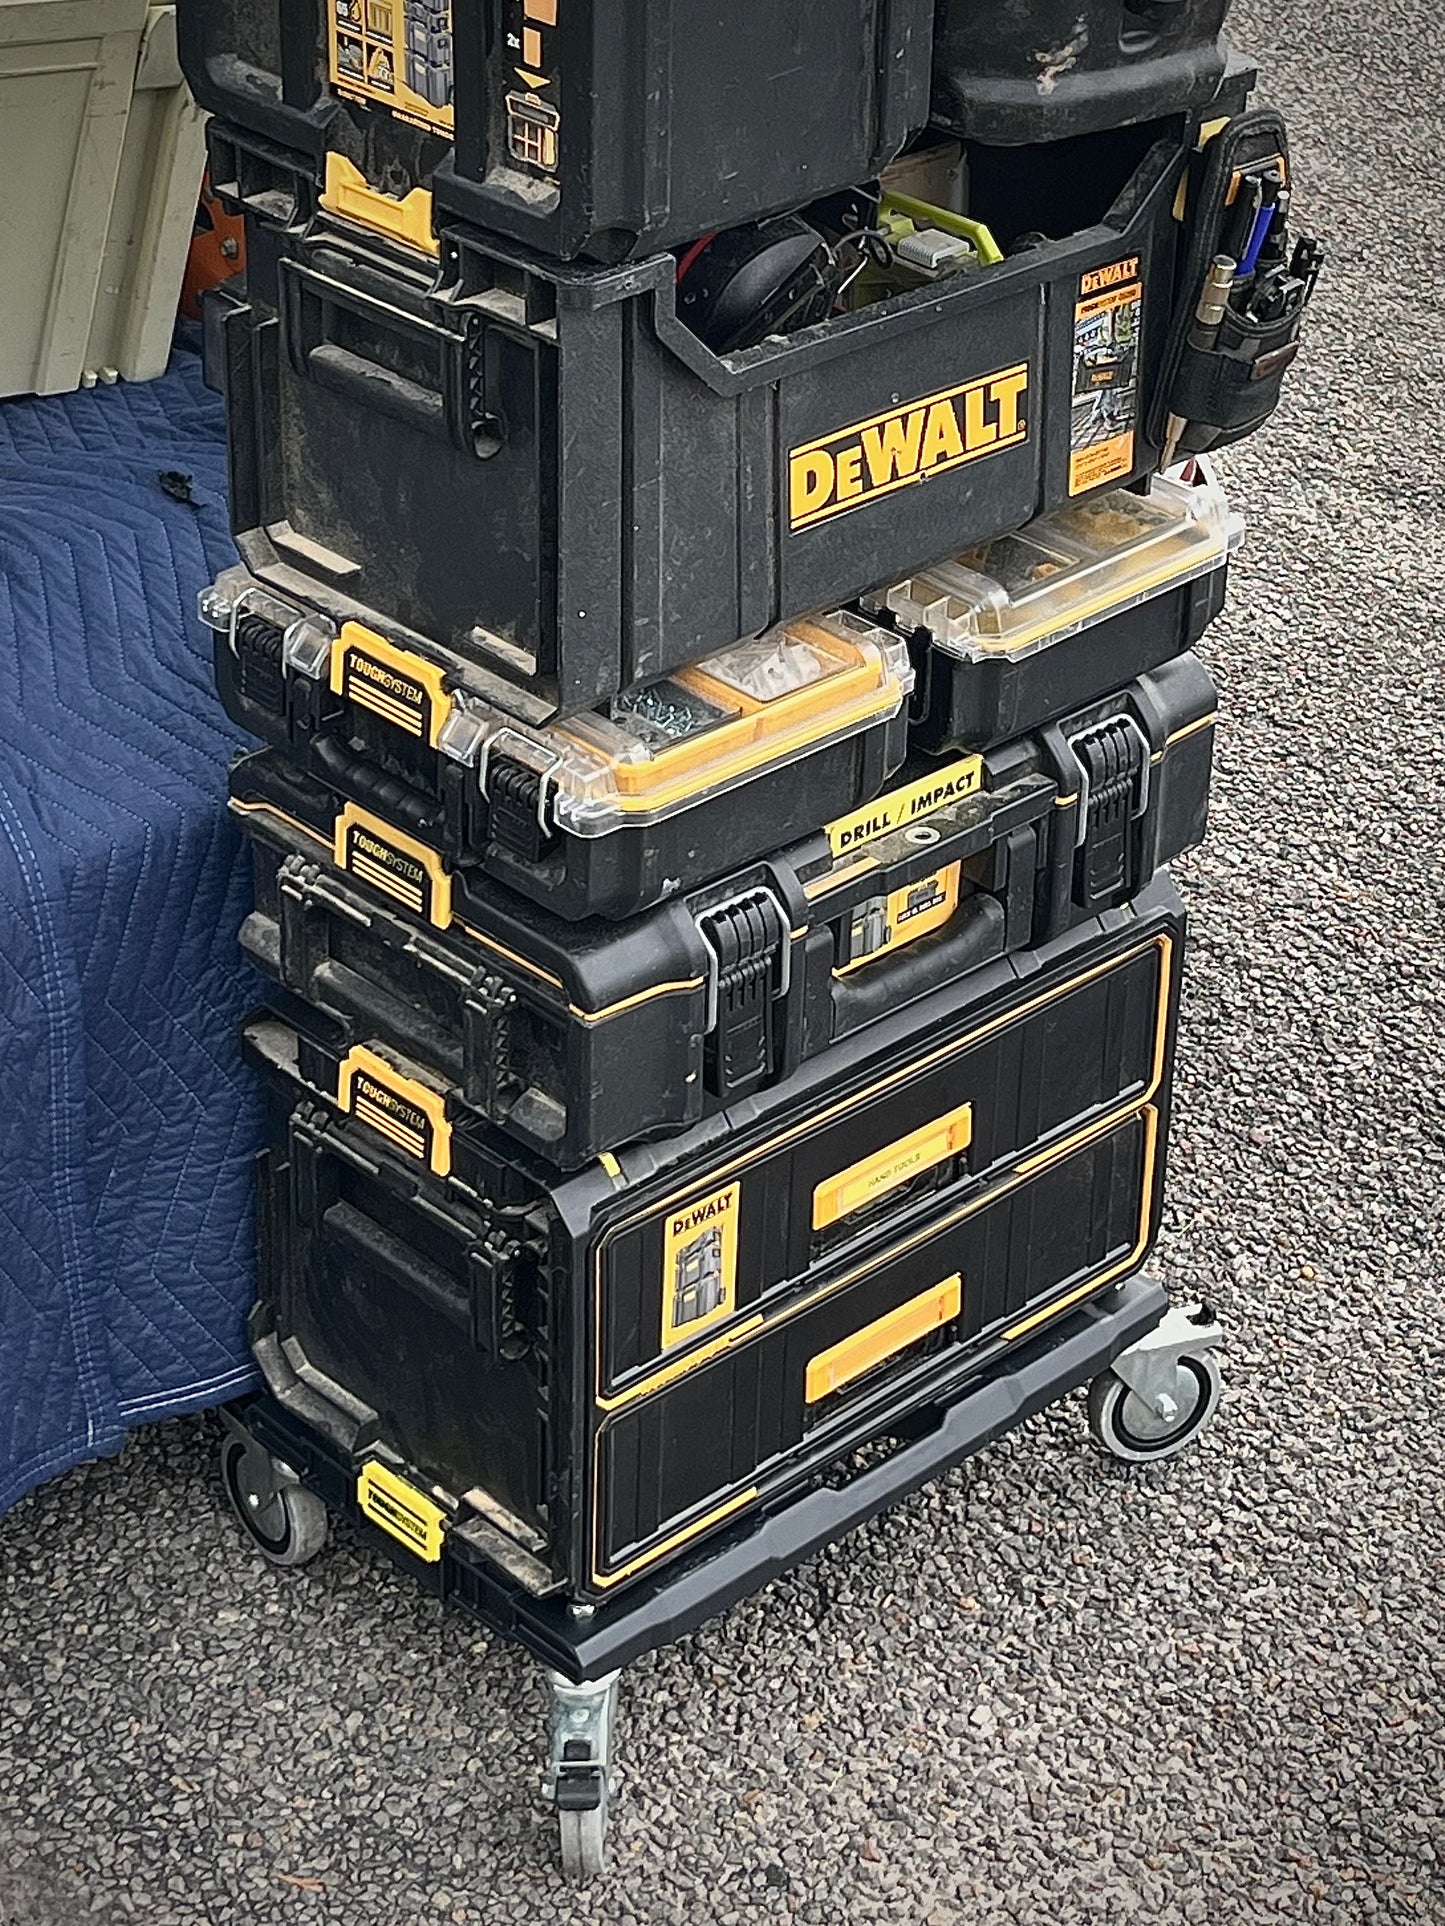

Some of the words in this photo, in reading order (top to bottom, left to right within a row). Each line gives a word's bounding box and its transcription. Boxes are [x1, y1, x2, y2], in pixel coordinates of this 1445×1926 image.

[1081, 256, 1138, 295] DEWALT
[790, 371, 1027, 519] DEWALT
[350, 653, 423, 704] TOUGHSYSTEM
[840, 812, 891, 848] DRILL
[911, 771, 975, 815] IMPACT
[353, 830, 423, 883] TOUGHSYSTEM
